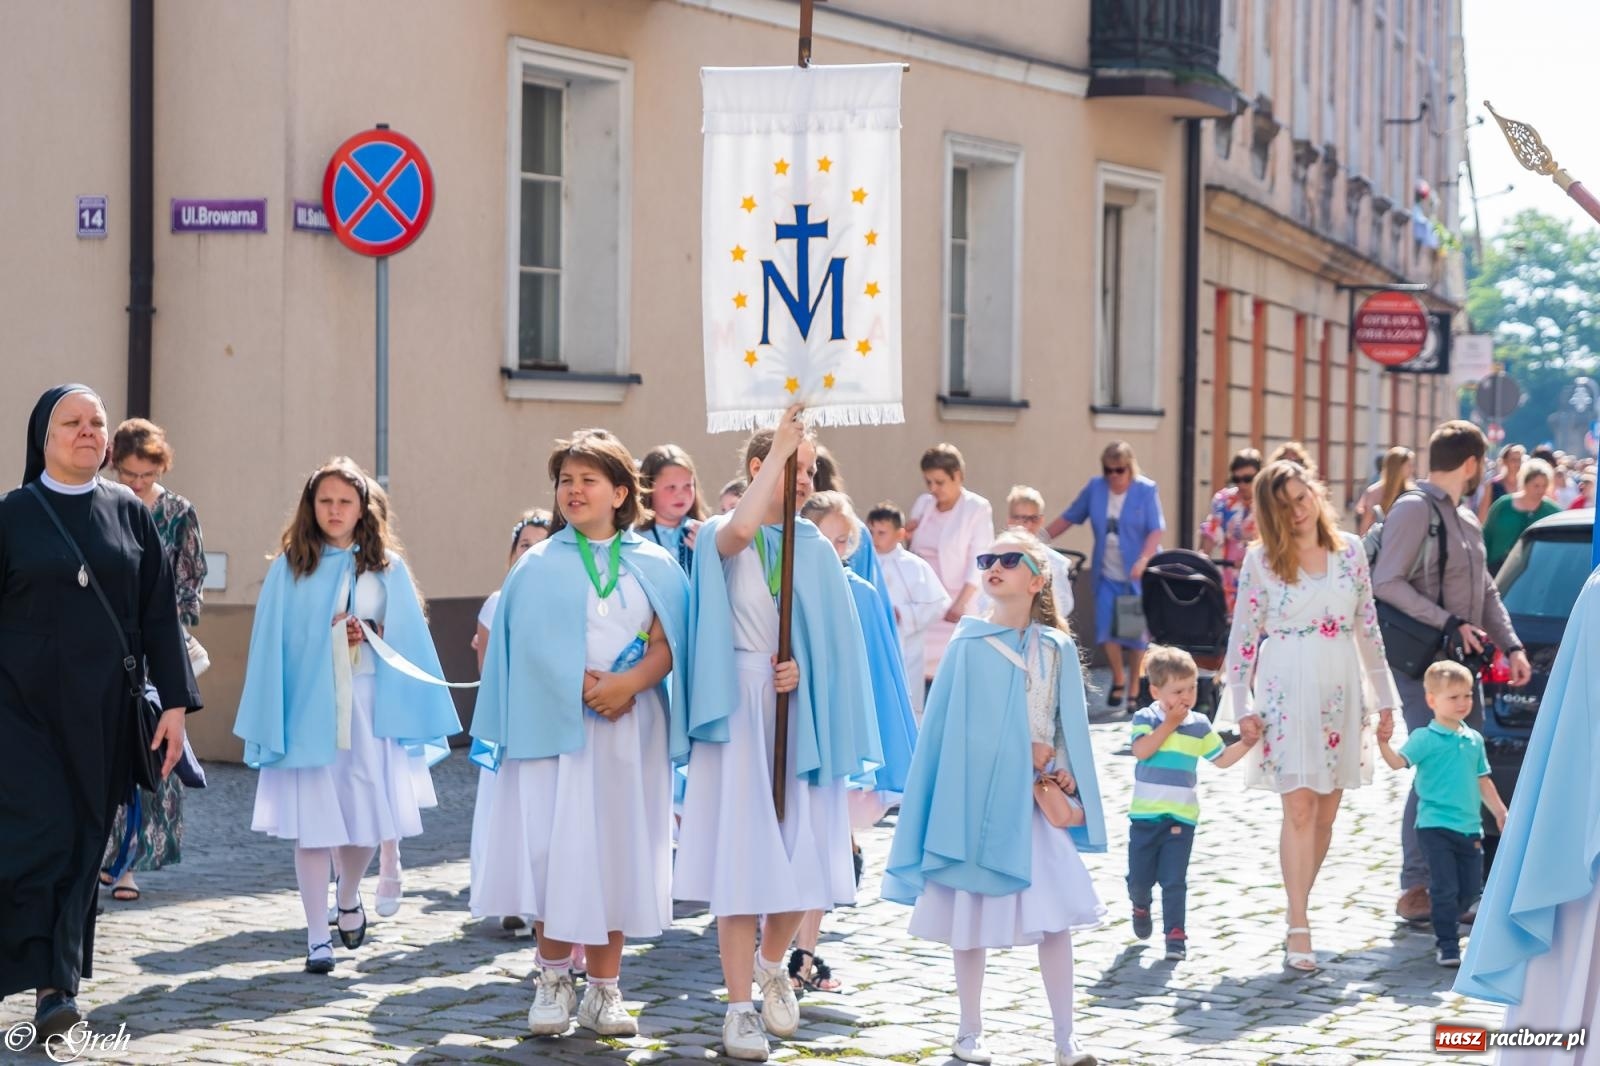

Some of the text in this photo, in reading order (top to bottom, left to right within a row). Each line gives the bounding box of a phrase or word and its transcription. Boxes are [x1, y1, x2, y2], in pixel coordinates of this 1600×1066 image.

[81, 208, 104, 227] 14
[181, 206, 258, 226] Ul.Browarna
[1503, 694, 1536, 703] GOLF
